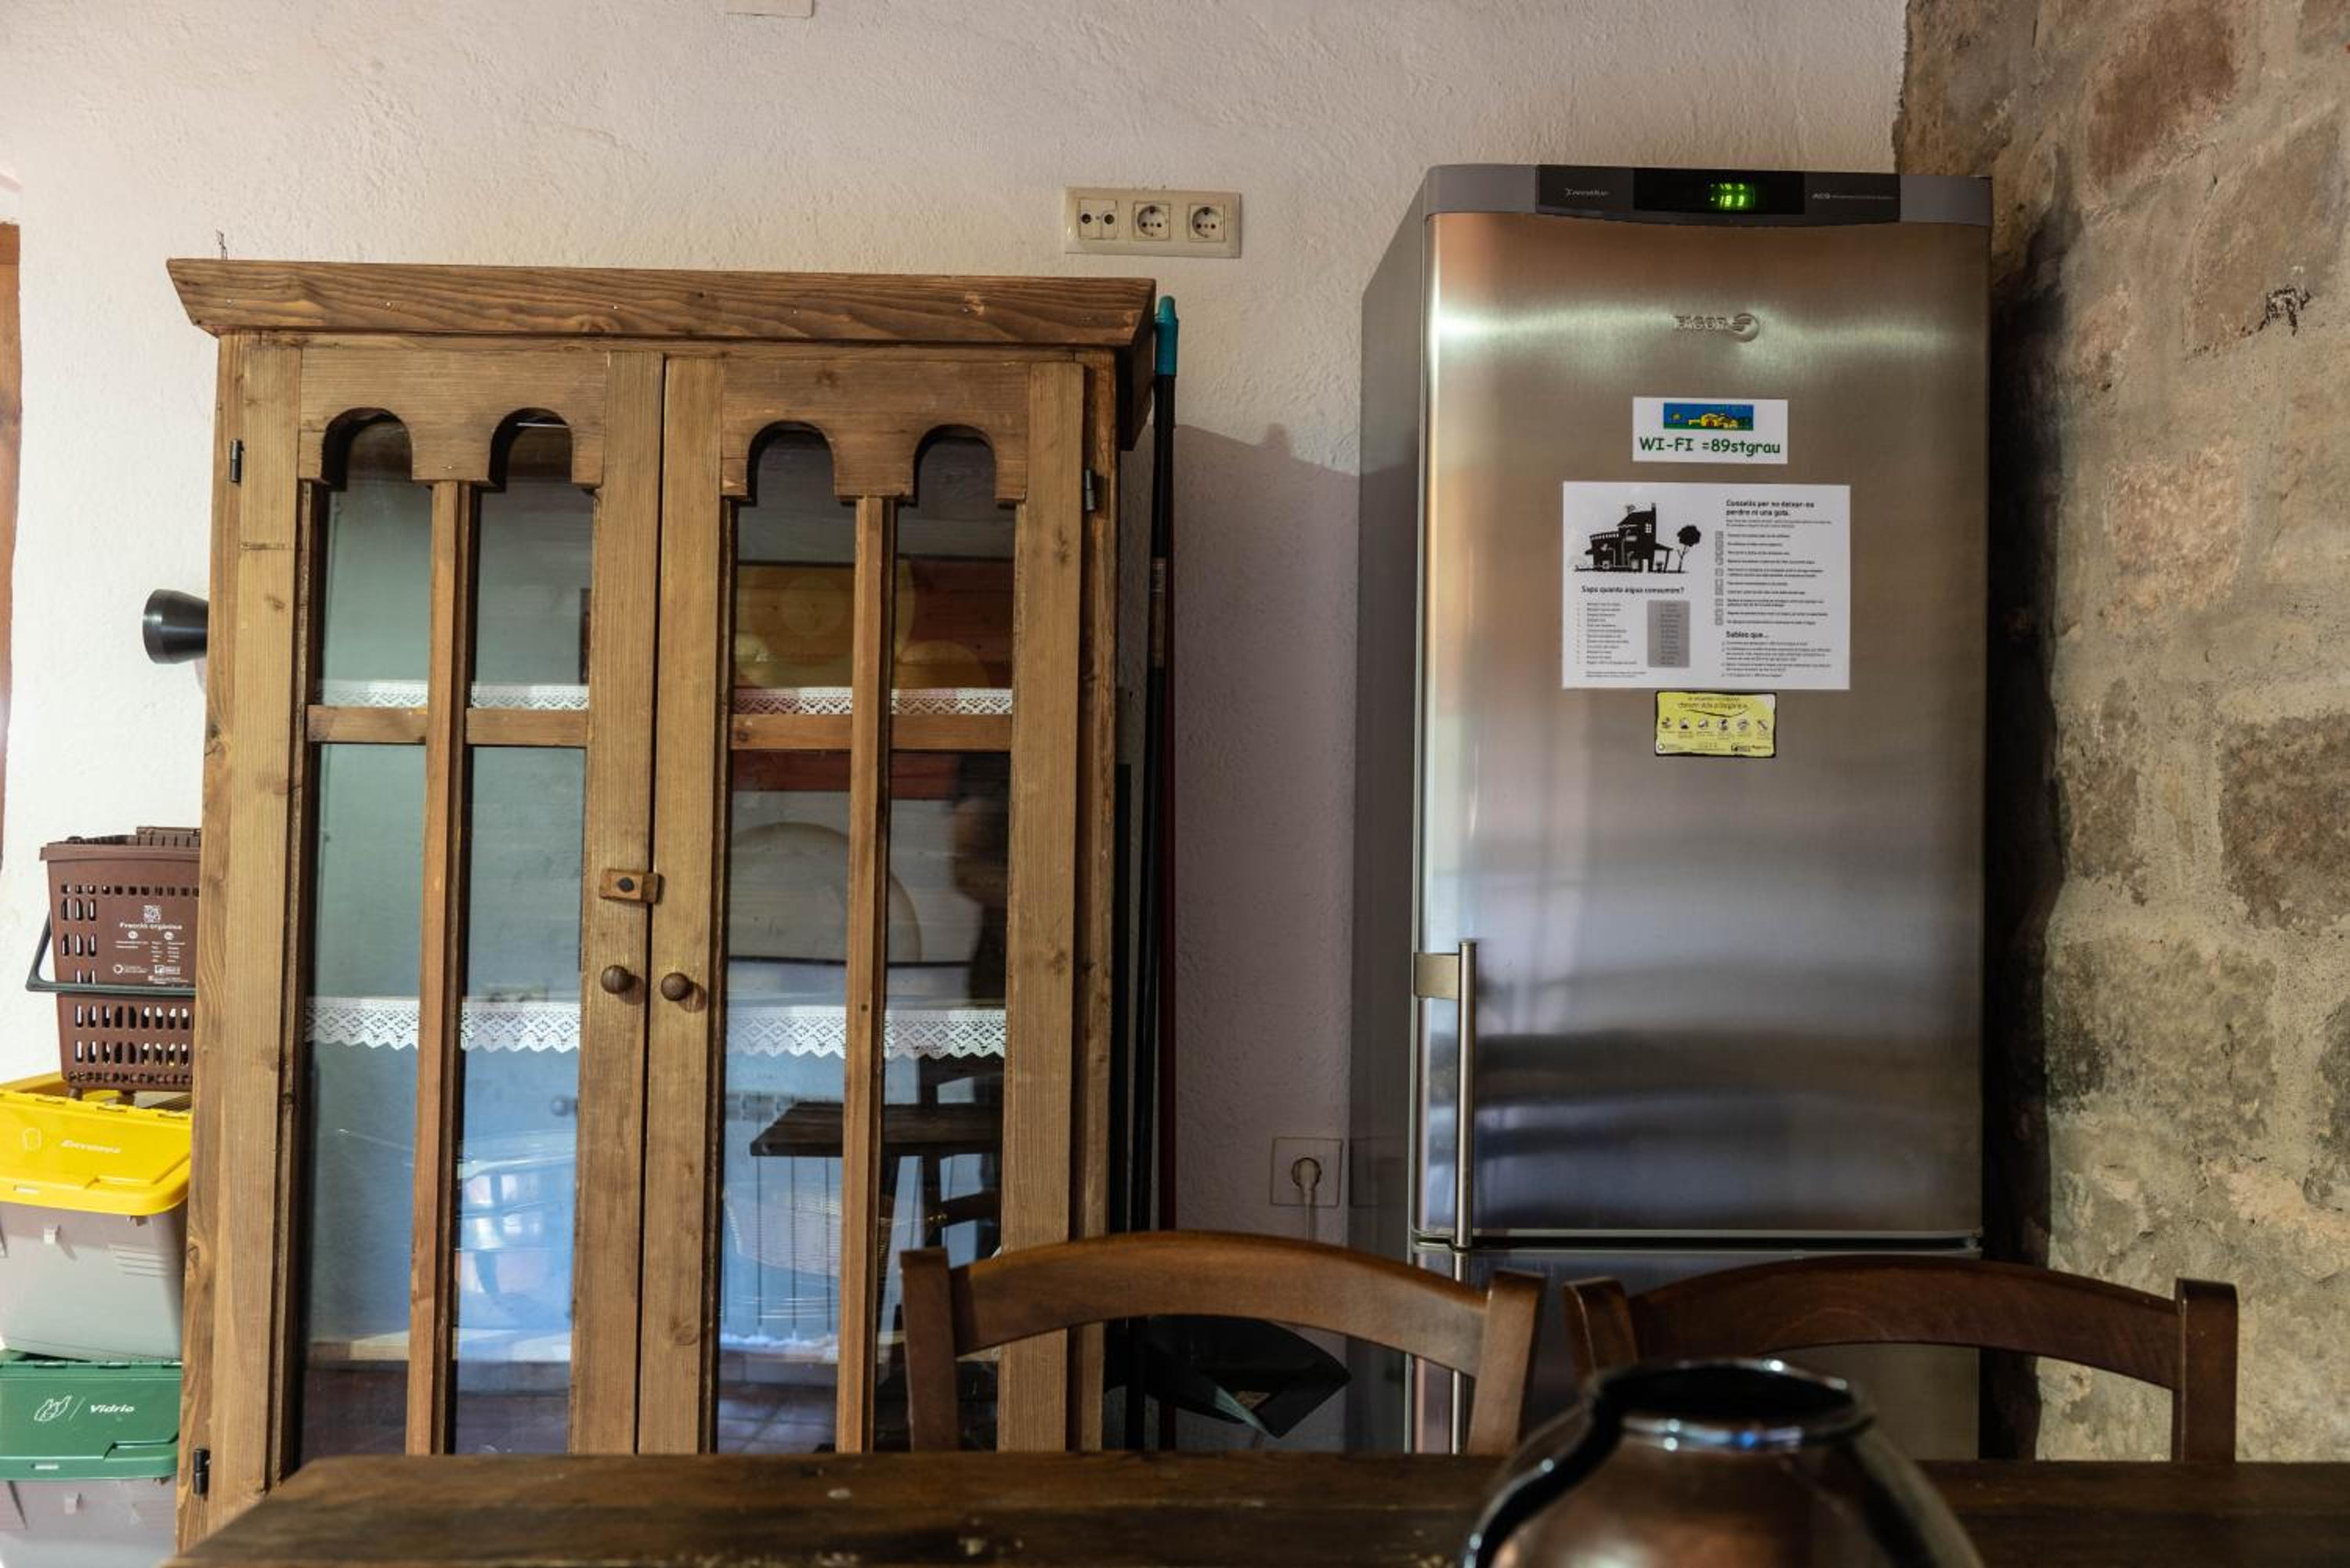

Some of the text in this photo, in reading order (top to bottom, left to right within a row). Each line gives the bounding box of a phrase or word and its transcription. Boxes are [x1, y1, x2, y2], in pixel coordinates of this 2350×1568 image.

[1639, 437, 1781, 457] WI-FI =89stgrau
[90, 1404, 135, 1413] Vidrio
